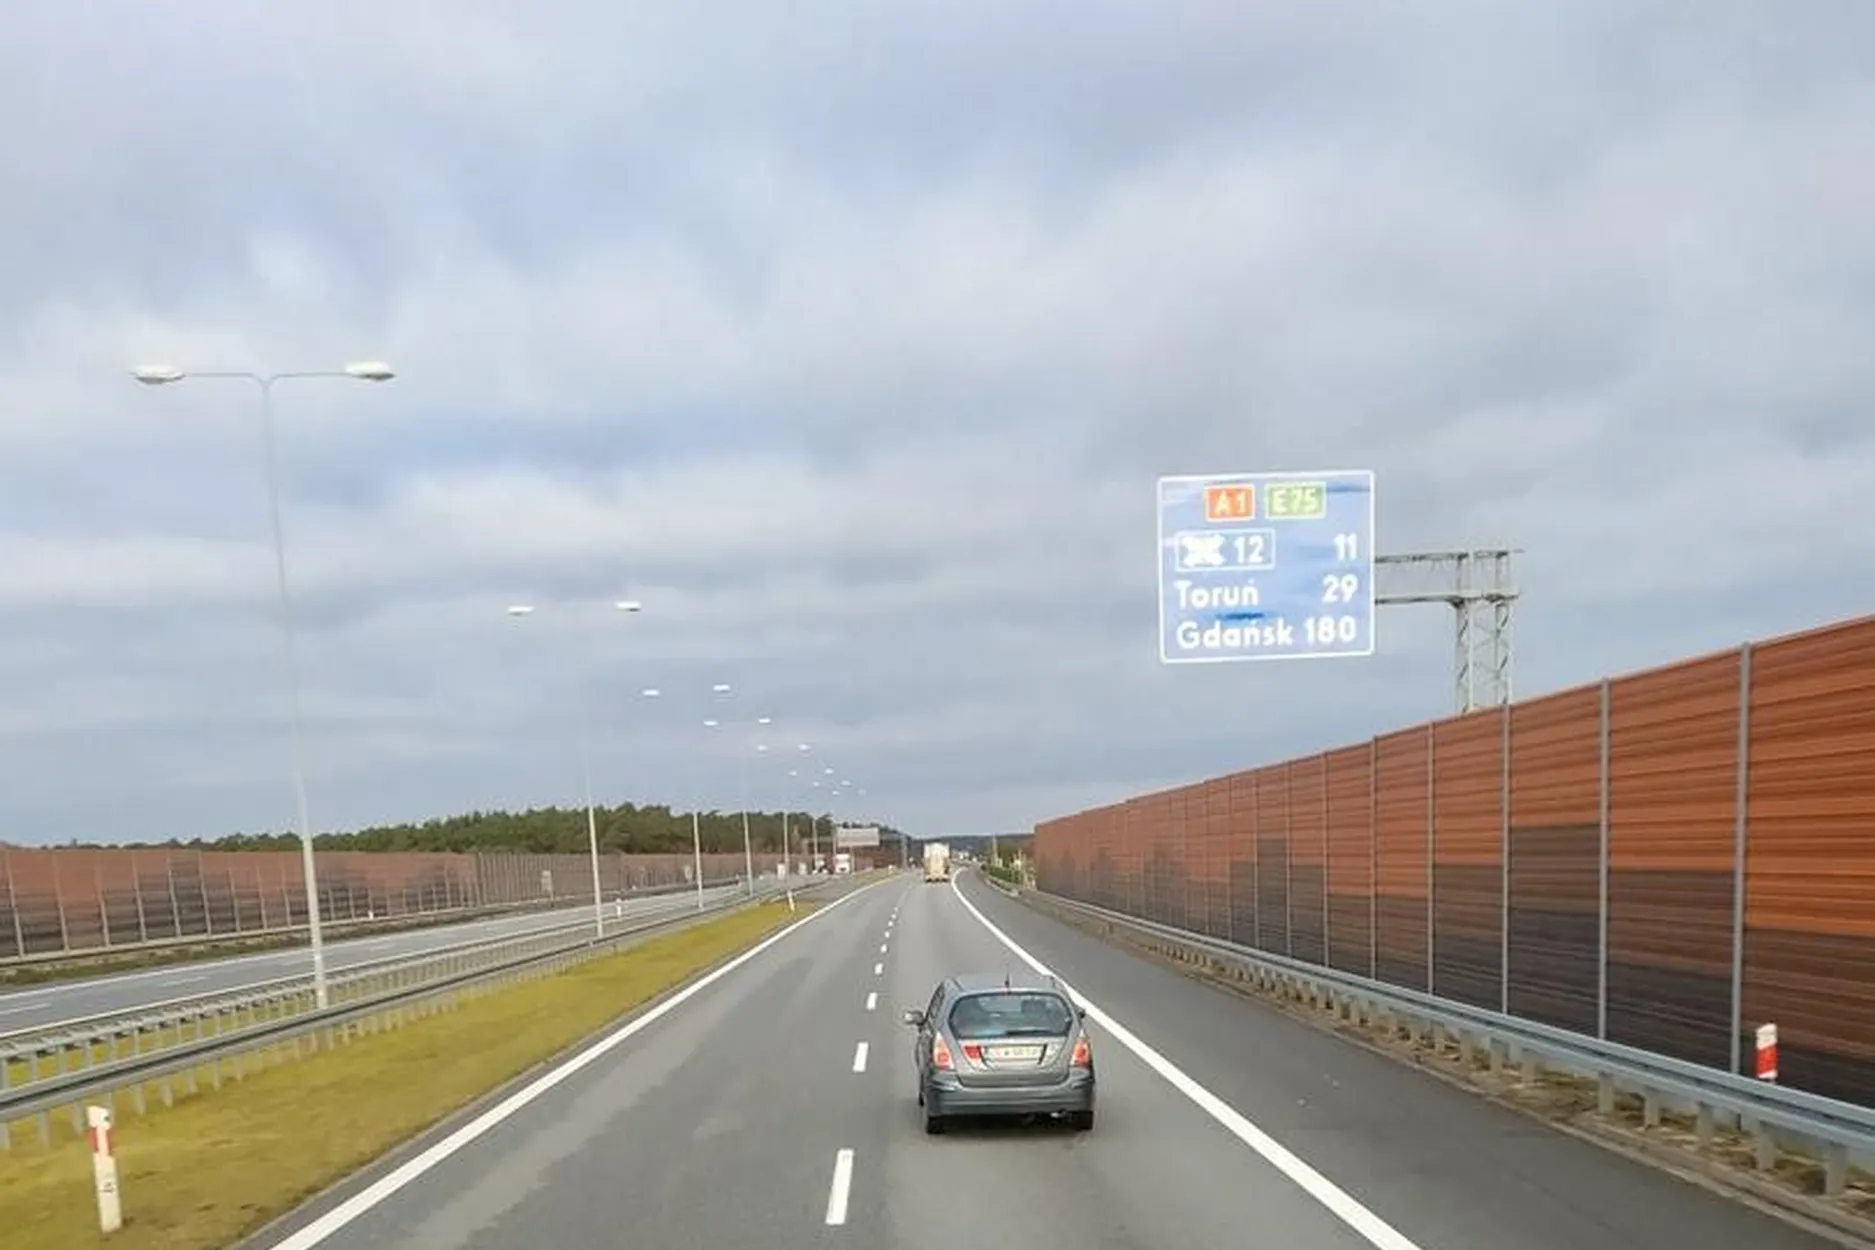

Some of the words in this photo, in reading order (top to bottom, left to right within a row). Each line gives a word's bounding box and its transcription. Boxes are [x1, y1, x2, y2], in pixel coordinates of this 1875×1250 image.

[1213, 490, 1247, 514] A1
[1272, 488, 1319, 514] E75
[1234, 536, 1264, 564] 12
[1334, 533, 1357, 561] 11
[1174, 578, 1259, 609] Toruń
[1322, 575, 1358, 604] 29
[1176, 617, 1293, 649] Gdańsk
[1304, 615, 1356, 647] 180
